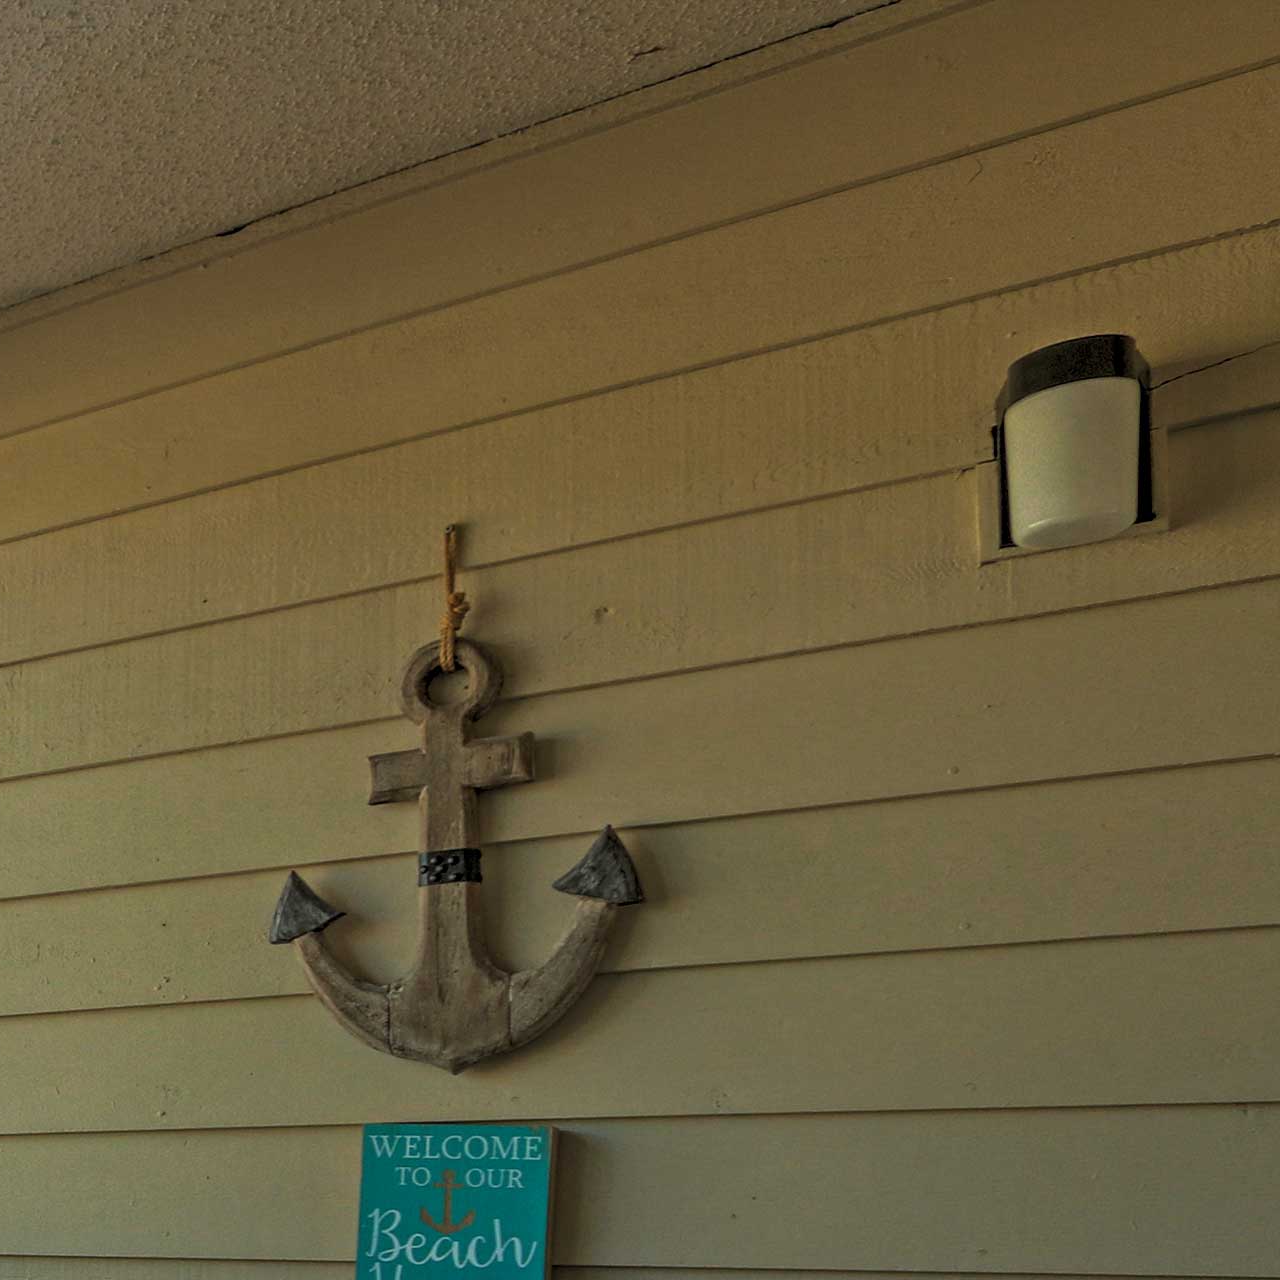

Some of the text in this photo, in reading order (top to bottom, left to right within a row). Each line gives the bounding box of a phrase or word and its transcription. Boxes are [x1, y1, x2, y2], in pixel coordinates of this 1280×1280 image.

[368, 1135, 542, 1160] WELCOME
[395, 1166, 525, 1189] TO OUR
[365, 1208, 538, 1269] Beach
